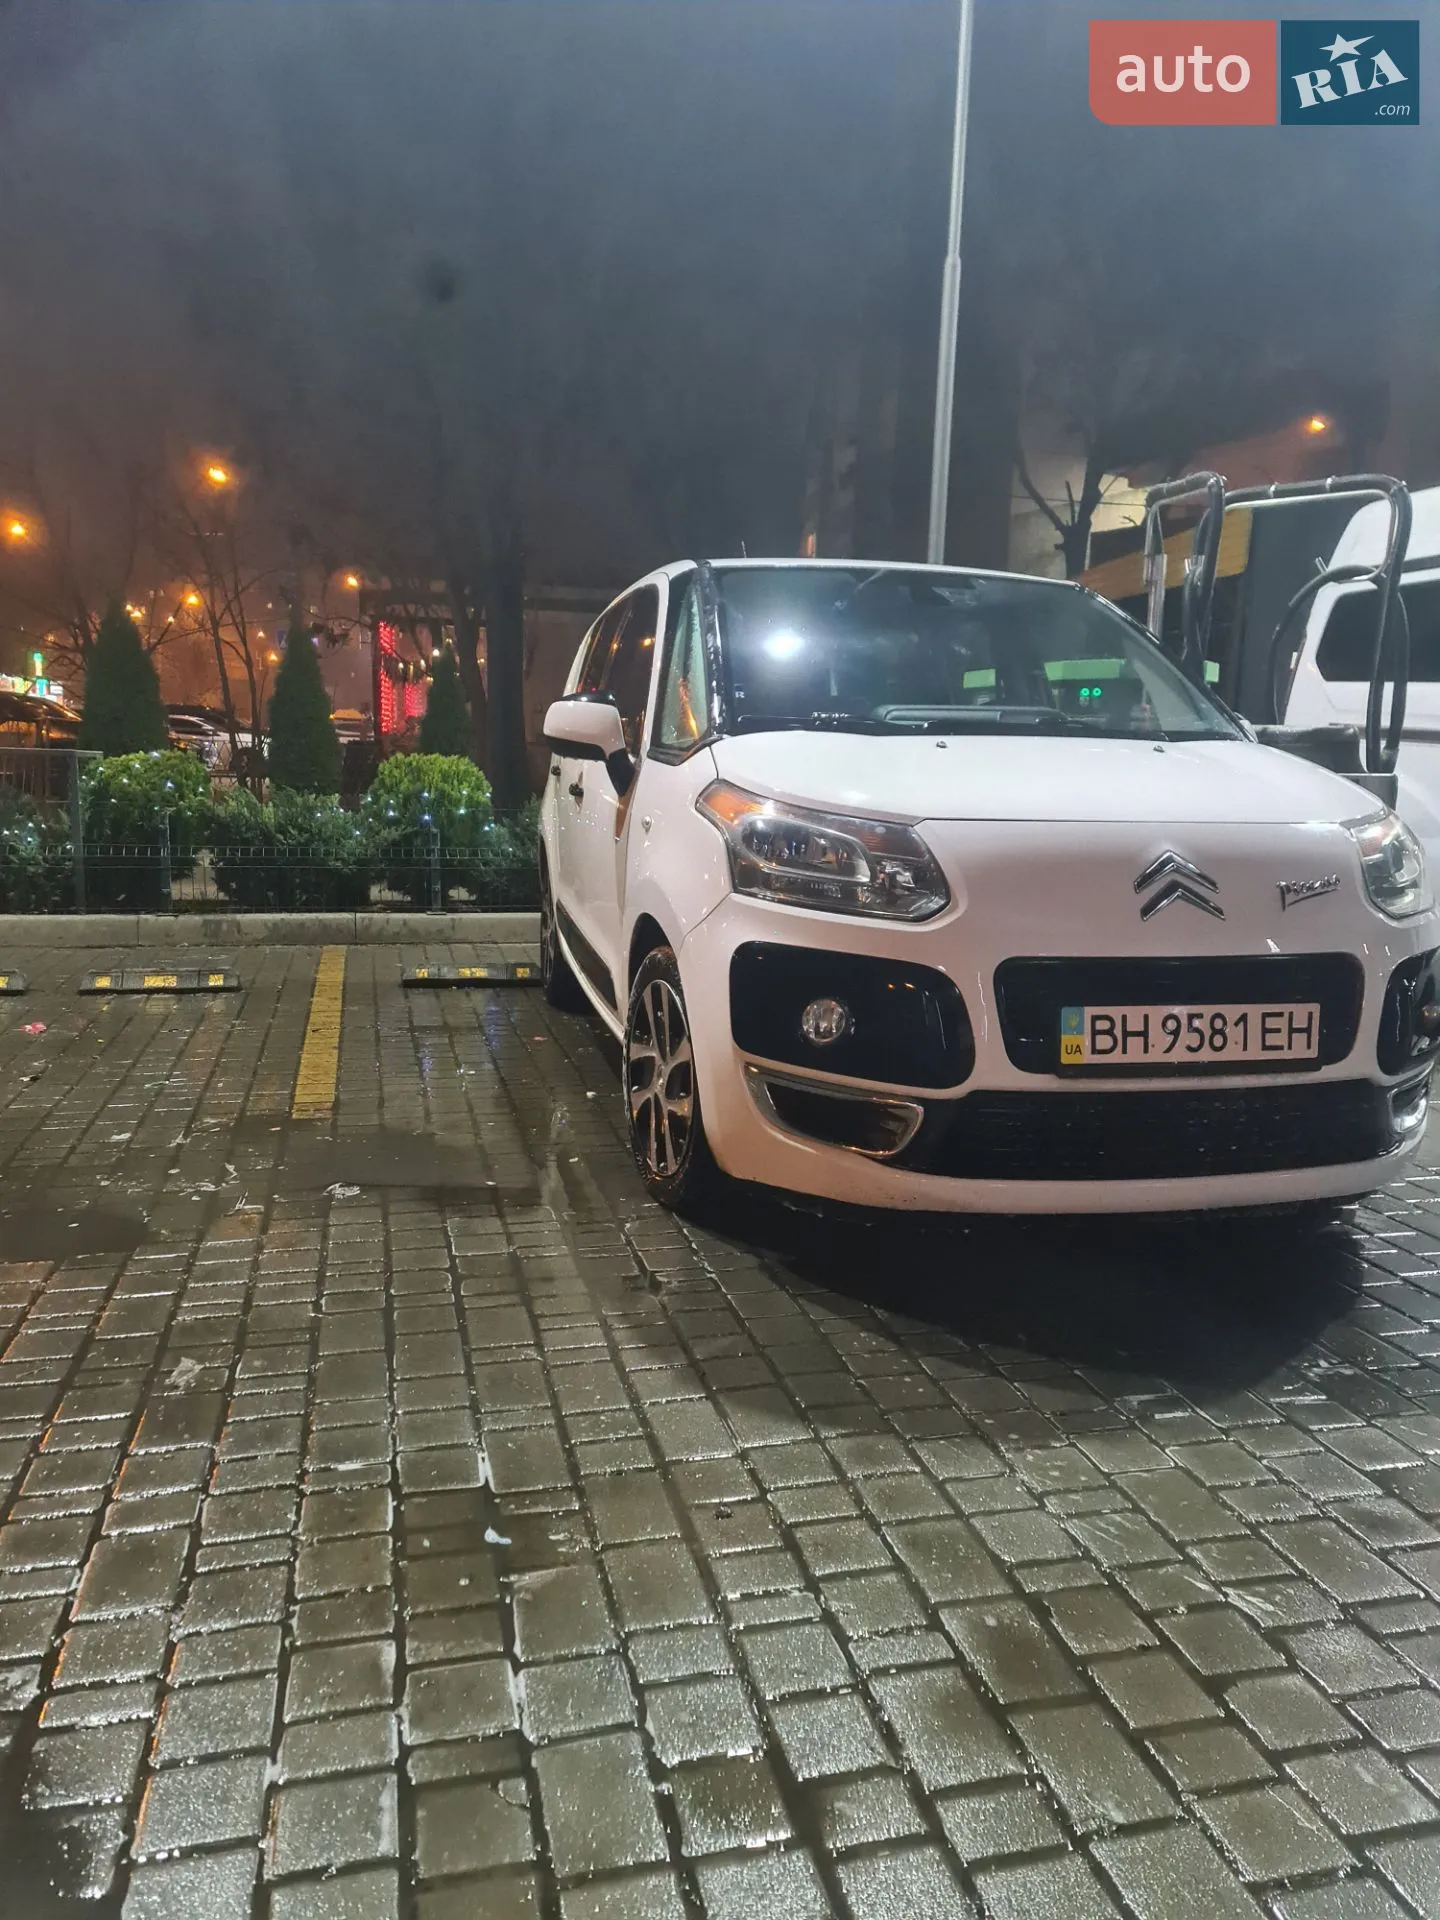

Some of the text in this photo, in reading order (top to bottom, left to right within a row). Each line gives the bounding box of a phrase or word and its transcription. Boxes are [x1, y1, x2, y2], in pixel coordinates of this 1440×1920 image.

[1090, 1011, 1313, 1055] BH 9581 EH
[1065, 1044, 1082, 1055] UA
